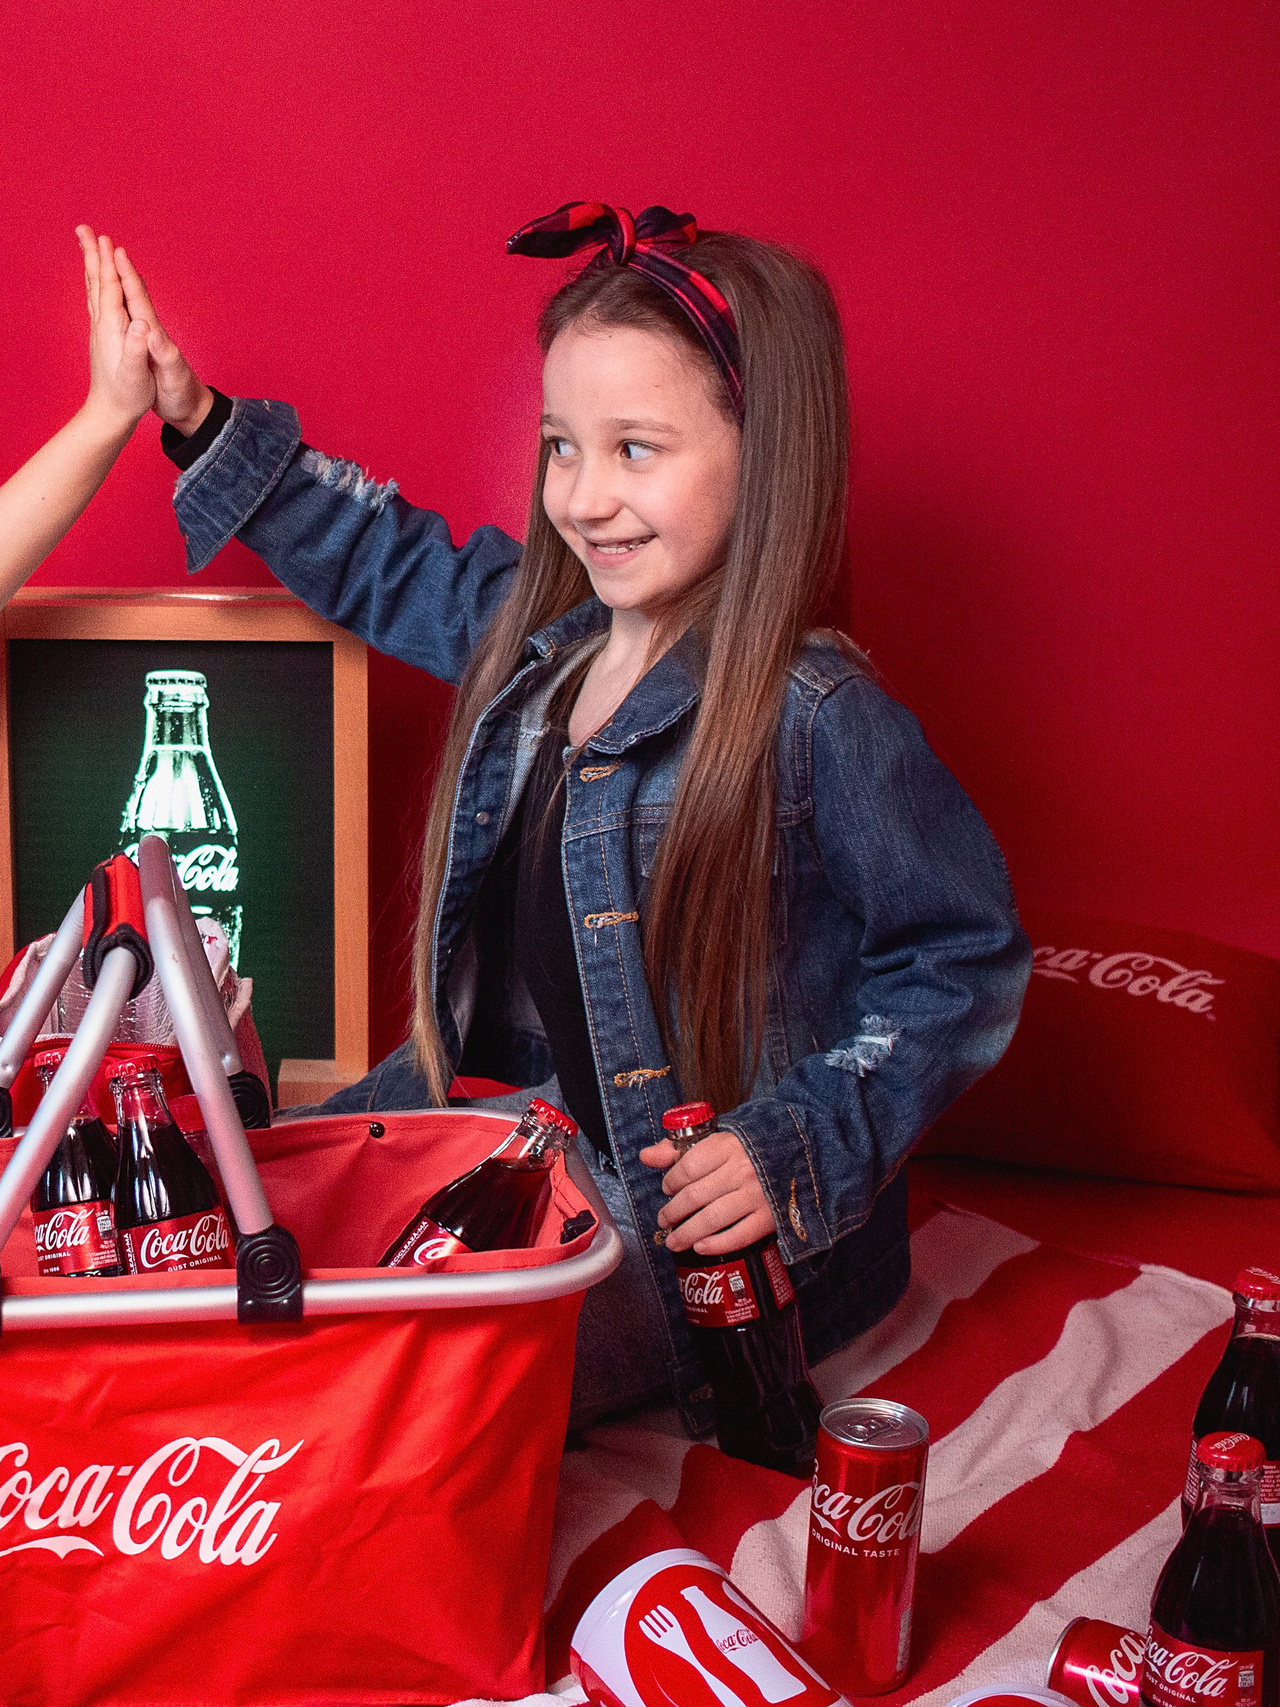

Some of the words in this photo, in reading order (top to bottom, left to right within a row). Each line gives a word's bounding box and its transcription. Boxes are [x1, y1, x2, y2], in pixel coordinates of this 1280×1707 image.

[140, 1213, 229, 1268] Coca-Cola
[45, 1252, 71, 1261] ORIGINAL
[167, 1262, 187, 1273] GUST
[189, 1254, 222, 1268] ORIGINAL
[812, 1528, 858, 1556] ORIGINAL
[863, 1548, 900, 1557] TASTE
[1160, 1684, 1196, 1703] ORIGINAL
